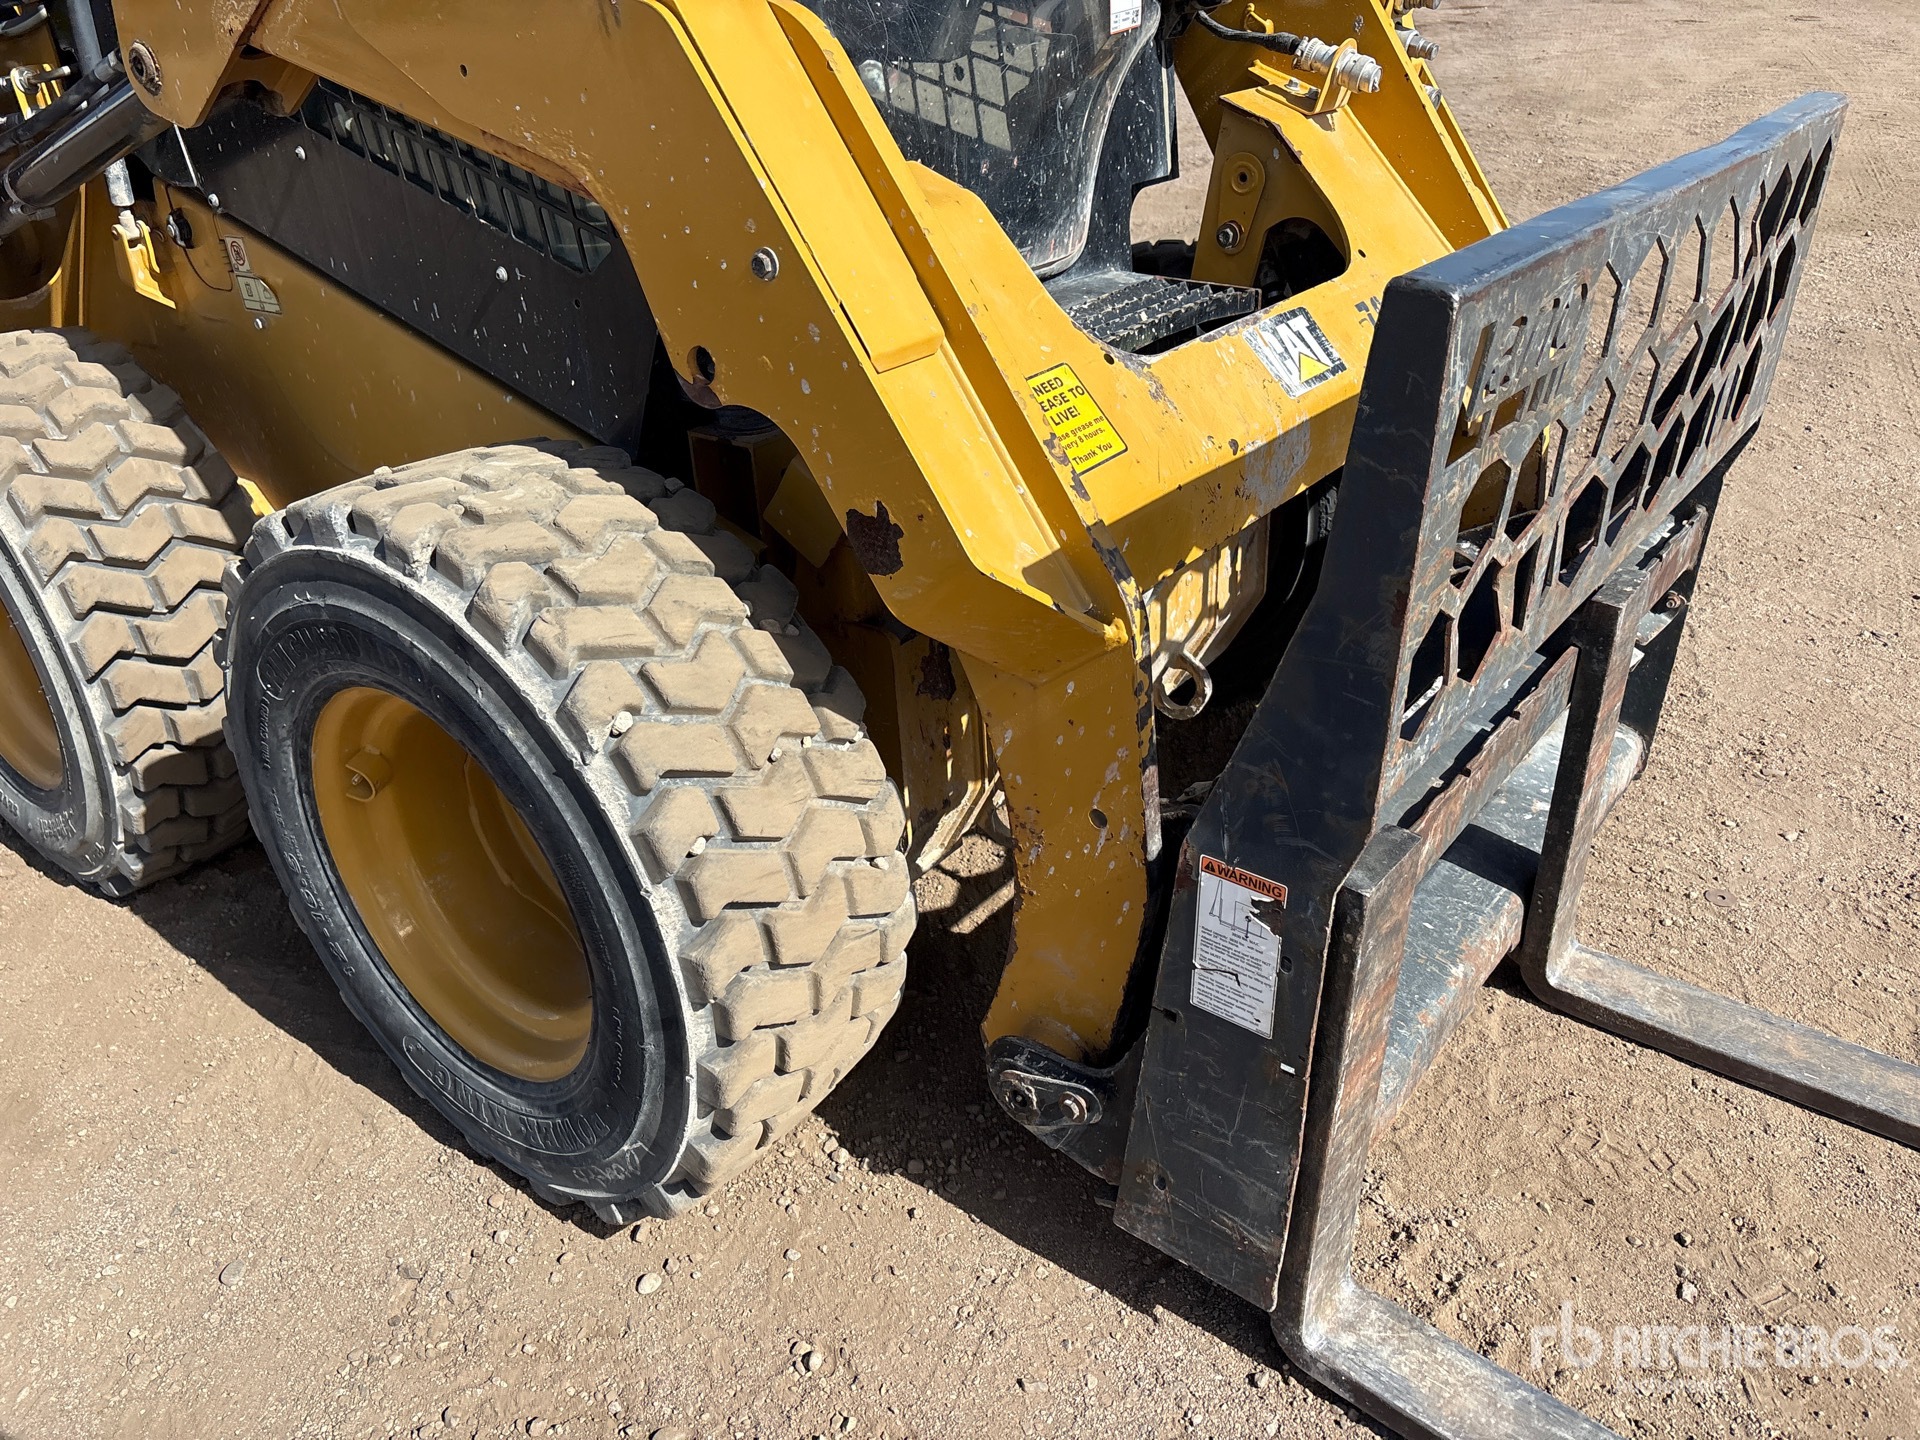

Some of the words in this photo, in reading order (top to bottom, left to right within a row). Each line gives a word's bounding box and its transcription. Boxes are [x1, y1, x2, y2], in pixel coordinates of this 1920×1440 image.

[1256, 313, 1335, 389] CAT
[1032, 376, 1064, 397] NEED
[1067, 385, 1085, 399] TO
[1050, 405, 1081, 426] LIVE!
[1071, 420, 1093, 437] grease
[1093, 415, 1105, 424] me
[1072, 449, 1098, 466] Thank
[1096, 441, 1113, 453] You
[1217, 863, 1282, 898] WARNING
[430, 1062, 514, 1138] KING
[519, 1112, 612, 1151] POWER
